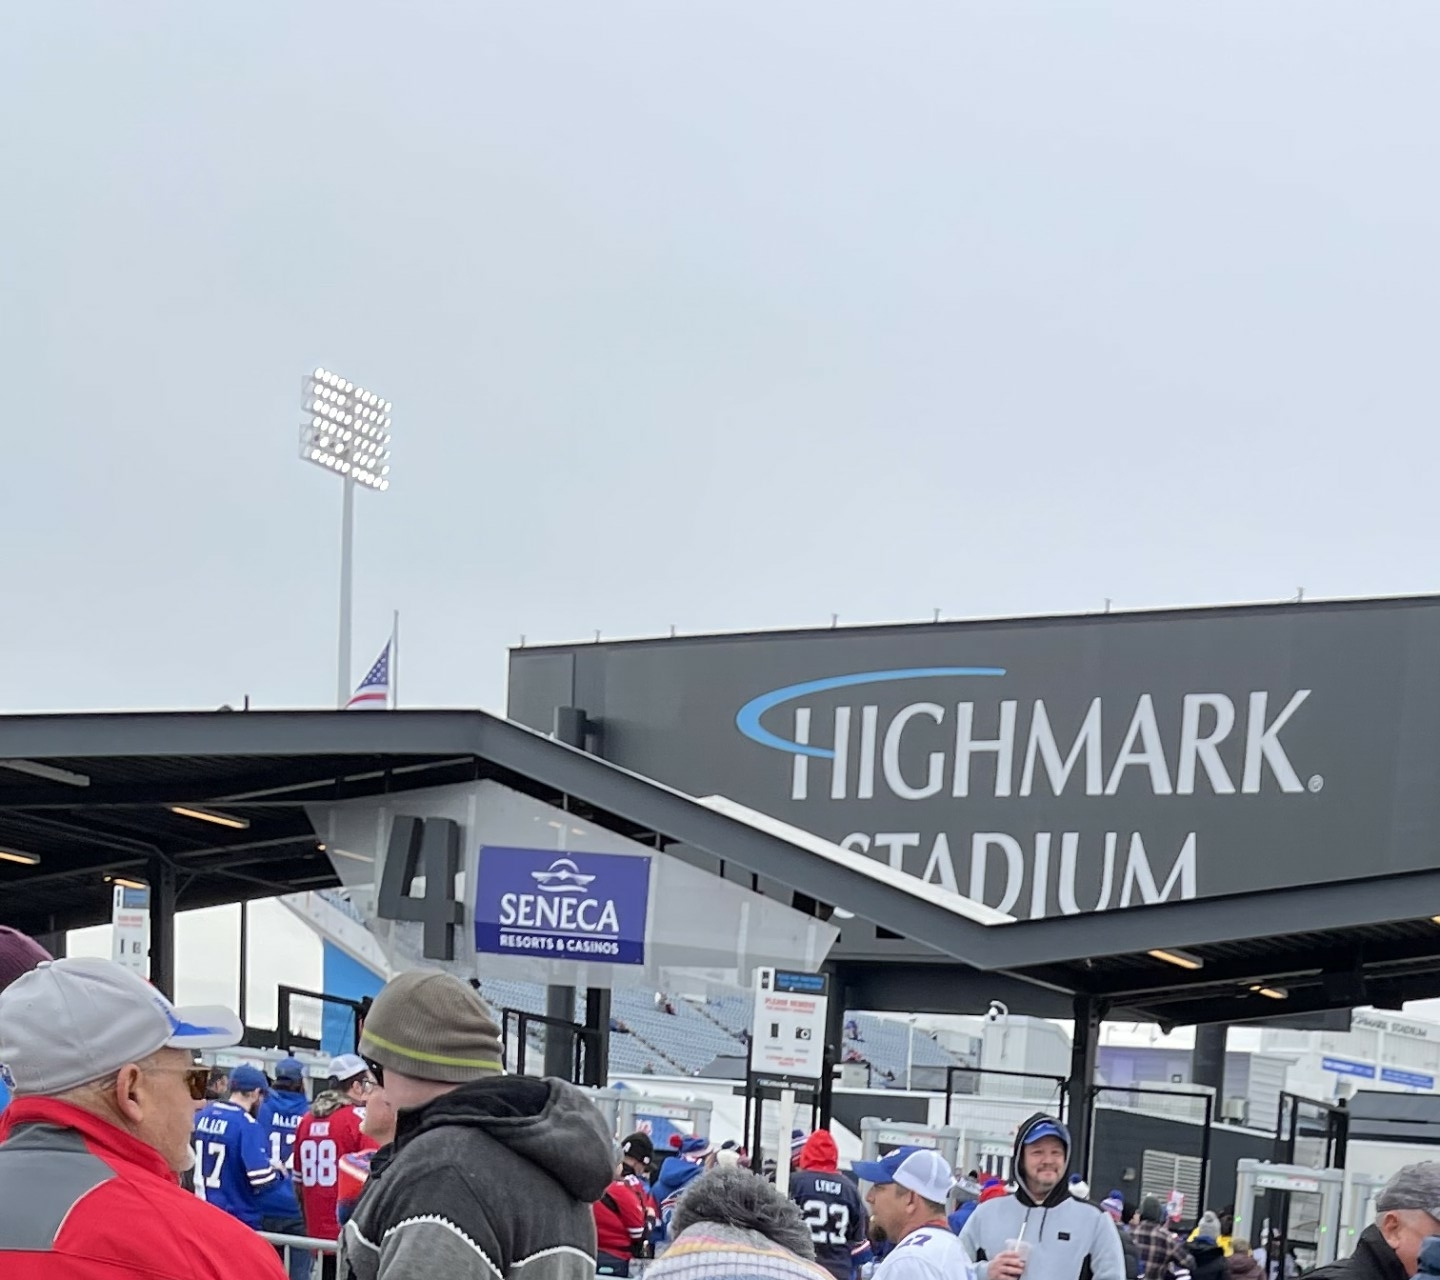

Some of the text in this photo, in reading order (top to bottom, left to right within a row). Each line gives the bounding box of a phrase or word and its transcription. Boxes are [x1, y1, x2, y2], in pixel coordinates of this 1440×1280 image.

[791, 688, 1312, 800] HIGHMARK
[377, 814, 465, 961] 4
[499, 892, 620, 933] SENECA
[499, 933, 619, 955] RESORTS & CASINOS
[197, 1116, 228, 1135] ALLEN
[193, 1139, 226, 1201] 17
[300, 1139, 338, 1188] 88
[815, 1179, 842, 1195] LYNCH
[803, 1199, 850, 1245] 23
